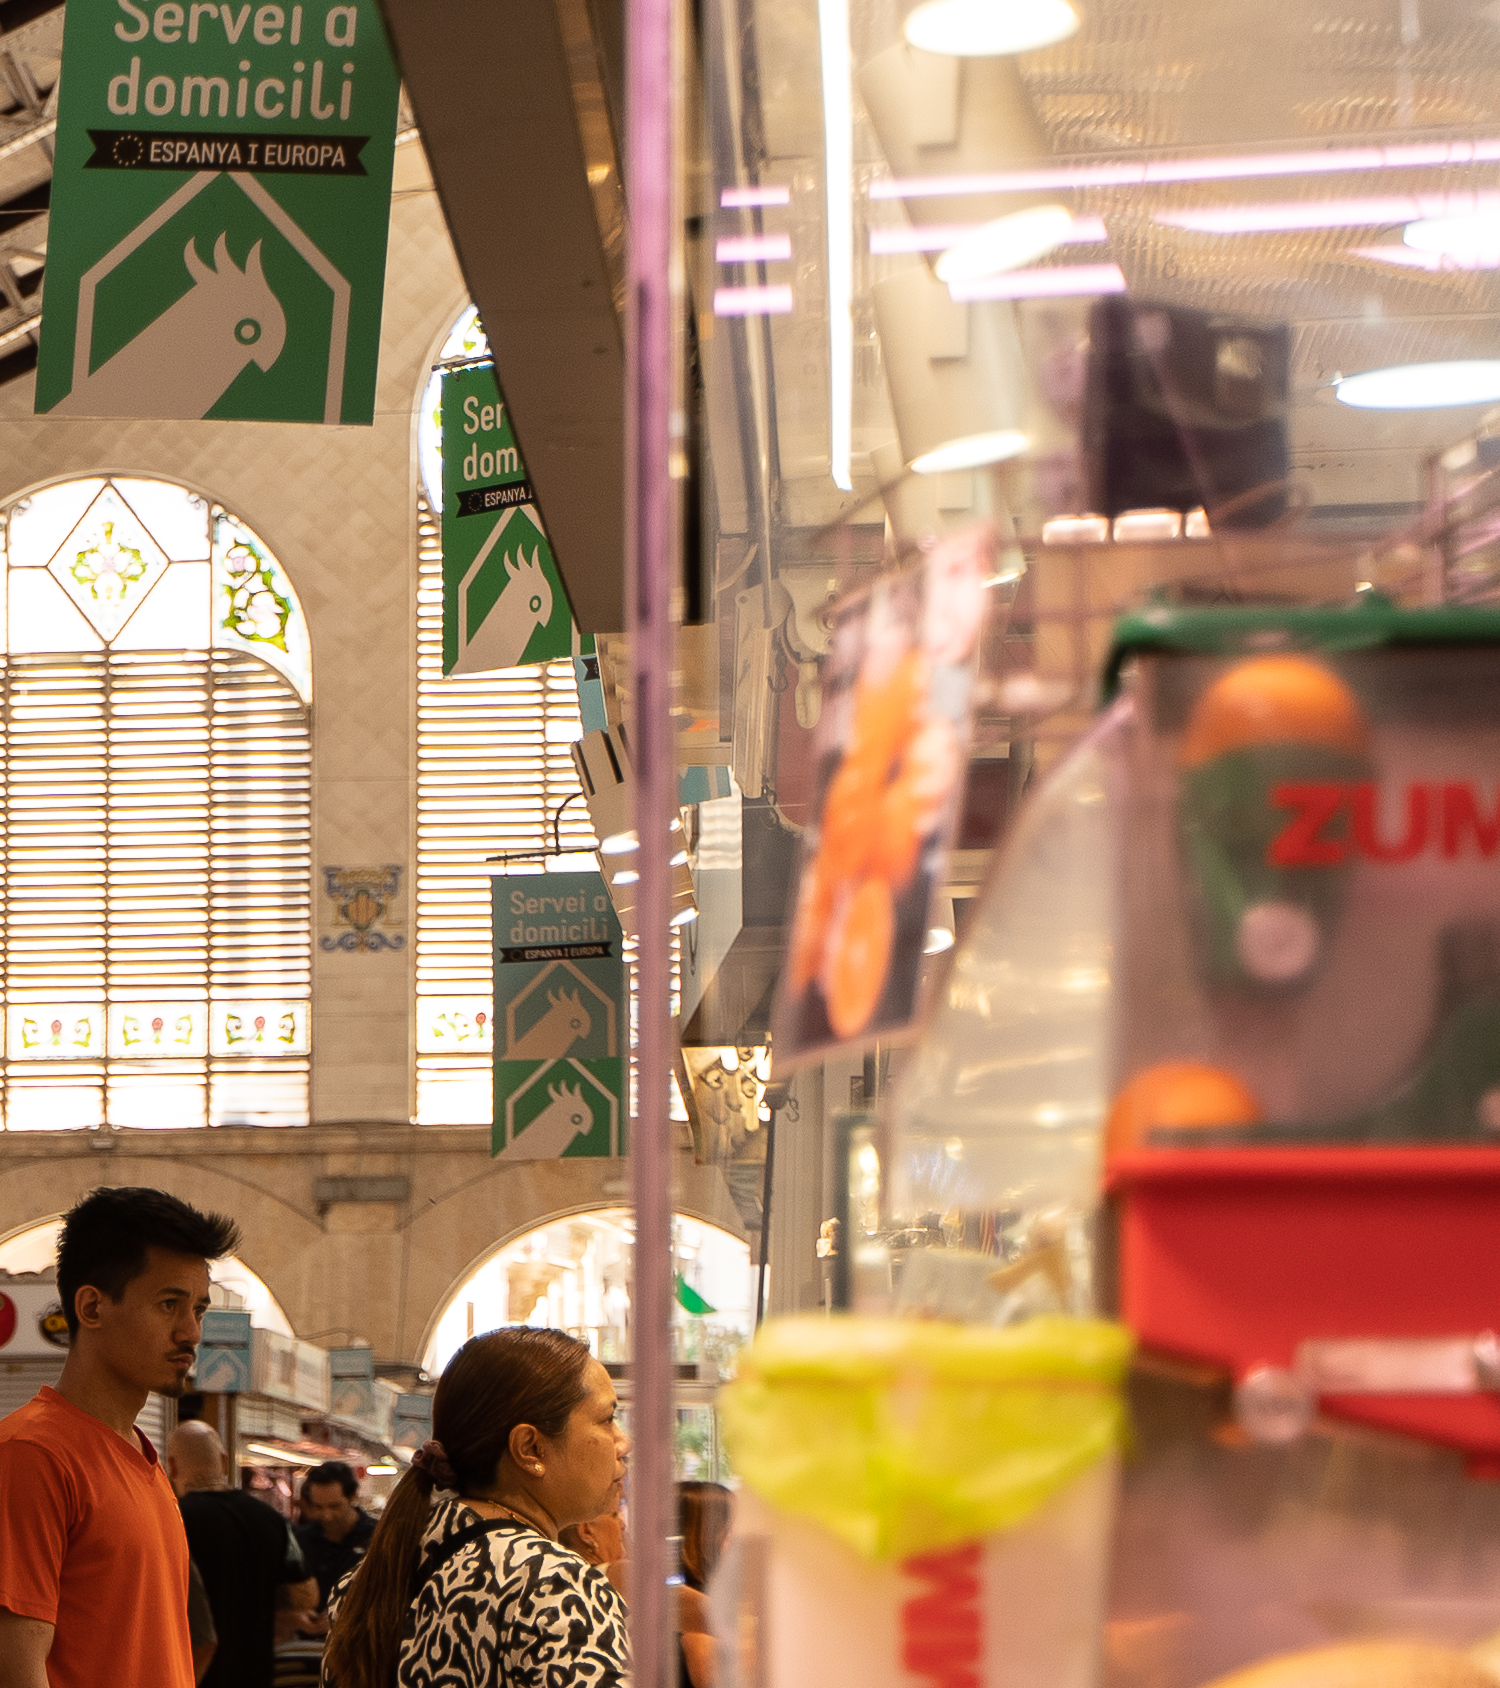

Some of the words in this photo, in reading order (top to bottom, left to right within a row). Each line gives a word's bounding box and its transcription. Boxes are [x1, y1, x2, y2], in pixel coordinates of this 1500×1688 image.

[113, 0, 301, 47] Servei
[324, 6, 356, 48] a
[106, 56, 354, 121] domicili
[149, 141, 242, 165] ESPANYA
[264, 145, 346, 168] EUROPA
[463, 442, 524, 482] dom
[484, 486, 526, 508] ESPANYA
[510, 889, 585, 915] Servei
[593, 895, 608, 912] a
[509, 918, 609, 943] domicili
